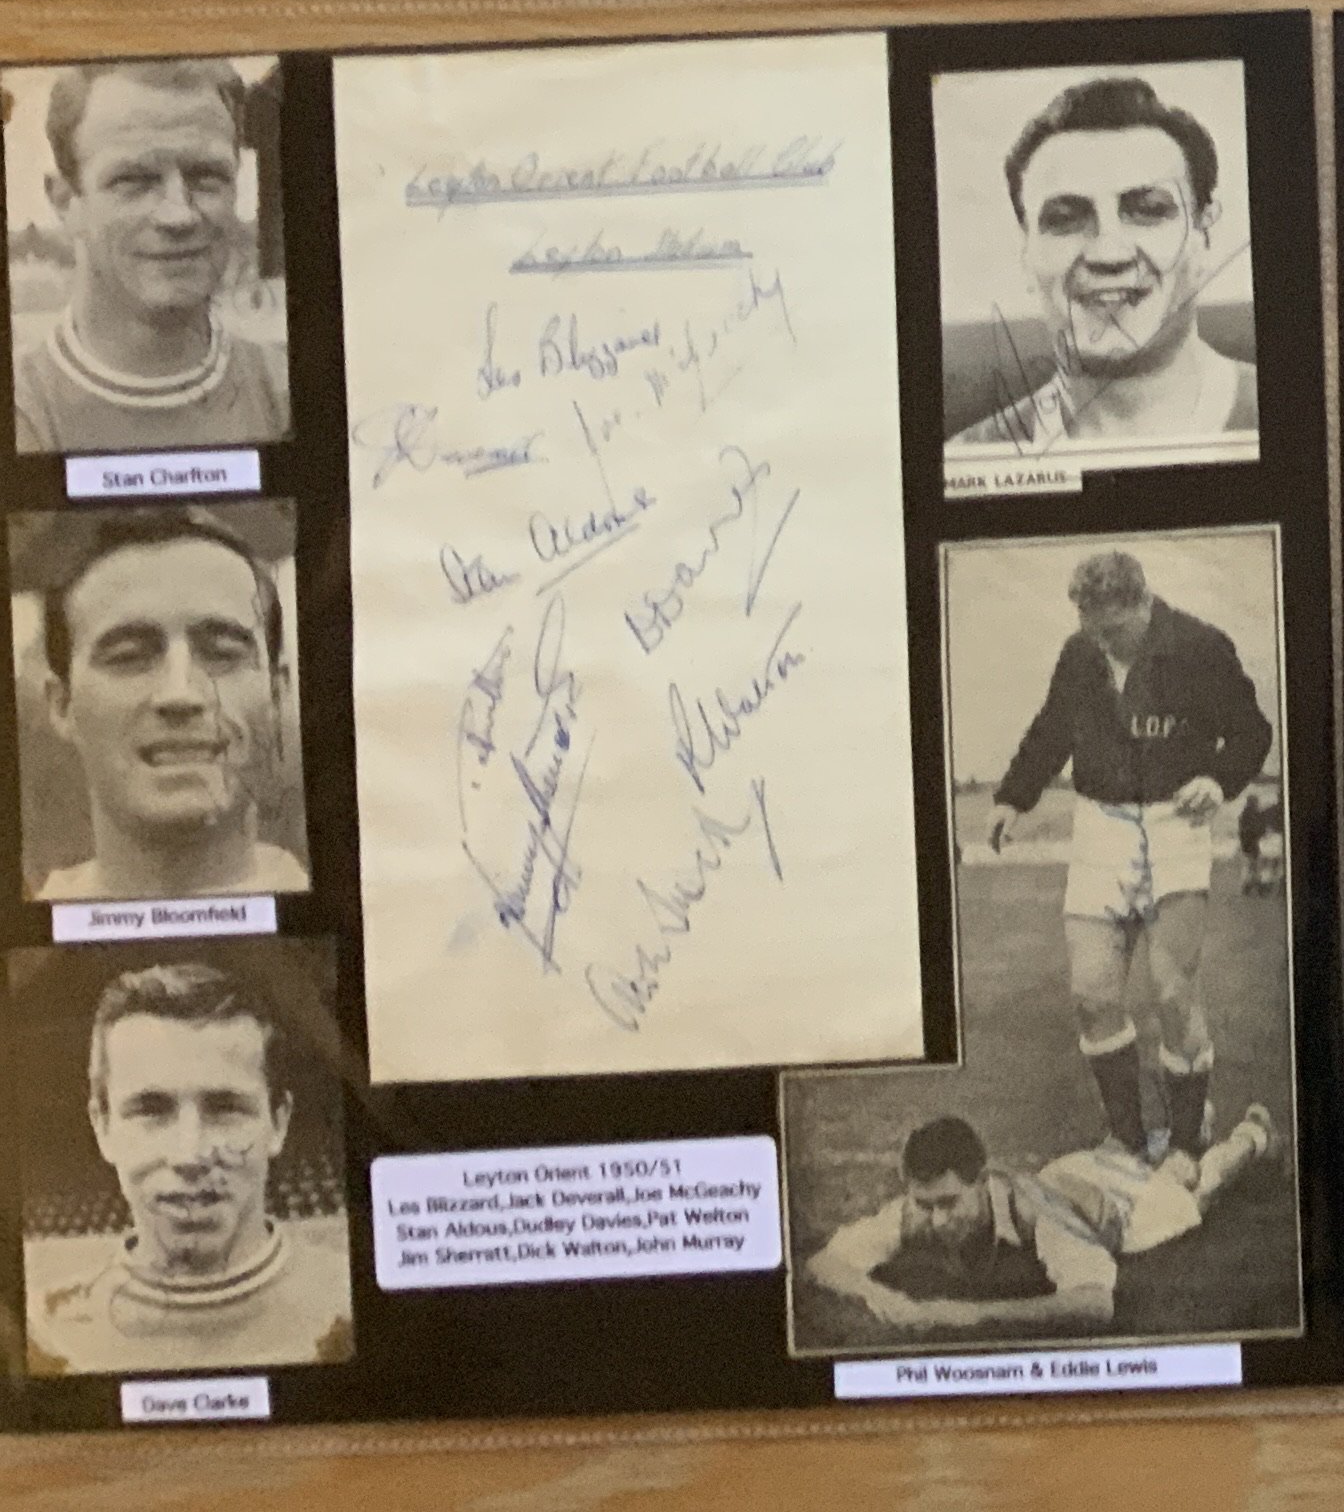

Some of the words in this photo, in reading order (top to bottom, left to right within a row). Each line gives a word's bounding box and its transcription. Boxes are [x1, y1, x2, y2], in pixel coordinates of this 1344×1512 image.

[102, 472, 144, 488] Stan
[150, 467, 228, 485] Charlton
[89, 910, 145, 928] Jimmy
[151, 905, 247, 924] Bloomfield
[462, 1168, 528, 1188] Leyton
[534, 1165, 590, 1183] Orient
[598, 1159, 682, 1179] 1950/51
[388, 1199, 420, 1216] Les
[669, 1180, 762, 1202] McGeachy
[396, 1223, 439, 1242] Stan
[684, 1208, 749, 1226] Welton
[398, 1249, 429, 1268] Jim
[682, 1233, 745, 1254] Murray
[896, 1366, 928, 1383] Phil
[934, 1364, 1024, 1382] Woosnam
[1030, 1363, 1043, 1378] &
[1050, 1360, 1100, 1377] Eddie
[1106, 1358, 1157, 1375] Lewis
[142, 1396, 187, 1413] Dave
[193, 1394, 249, 1410] Clarke
